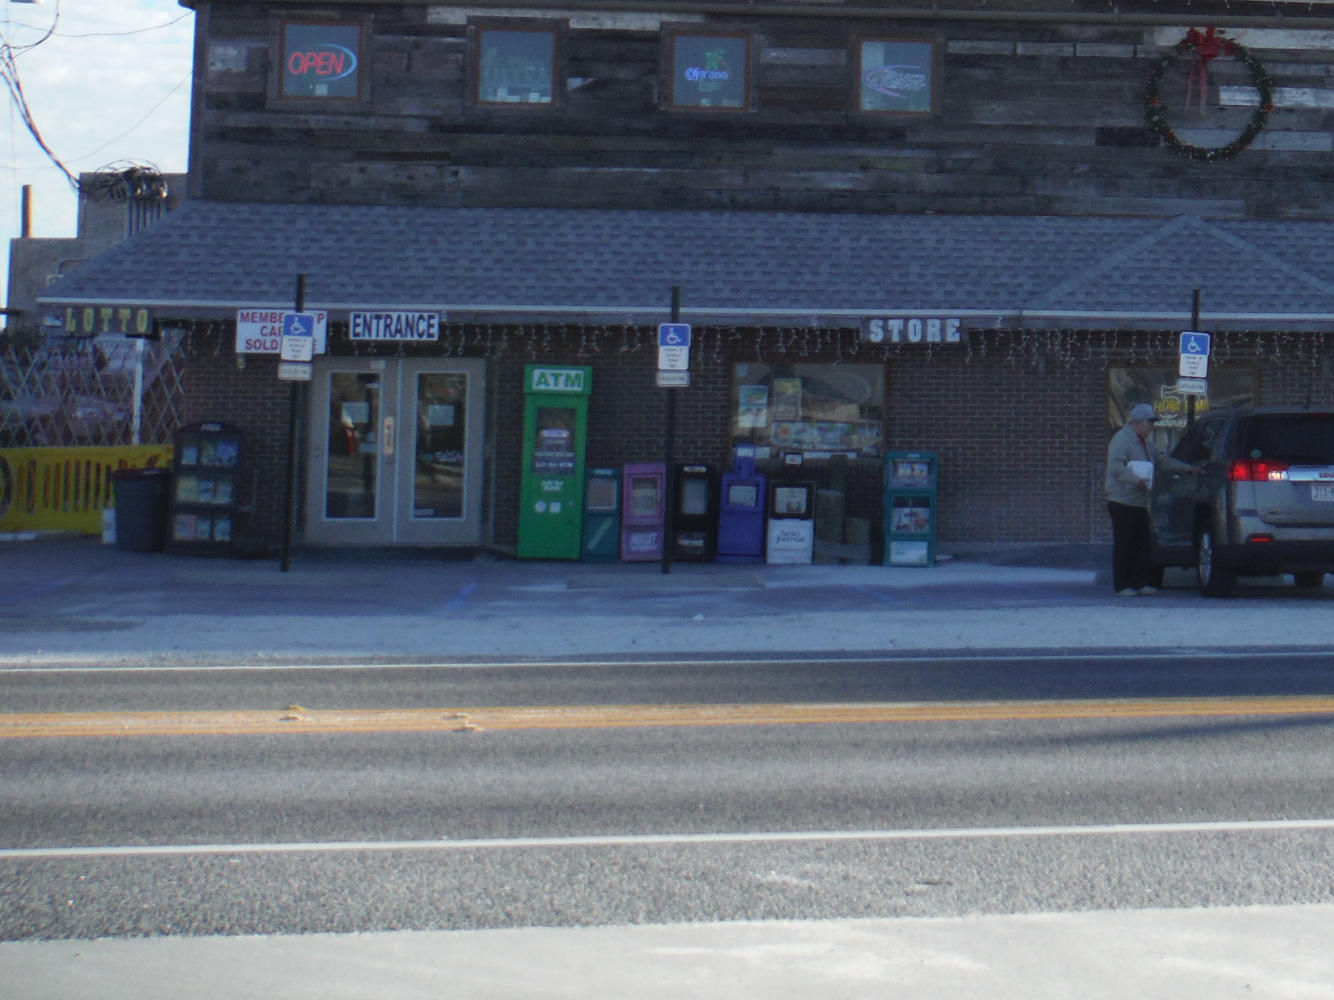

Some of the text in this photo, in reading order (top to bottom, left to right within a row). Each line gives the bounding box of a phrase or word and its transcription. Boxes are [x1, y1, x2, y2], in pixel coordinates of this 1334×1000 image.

[288, 51, 345, 75] OPEN
[685, 66, 729, 81] Corona
[65, 307, 148, 332] LOTTO
[352, 313, 437, 339] ENTRANCE
[869, 318, 960, 342] STORE
[245, 339, 278, 351] SOLD
[535, 371, 582, 388] ATM
